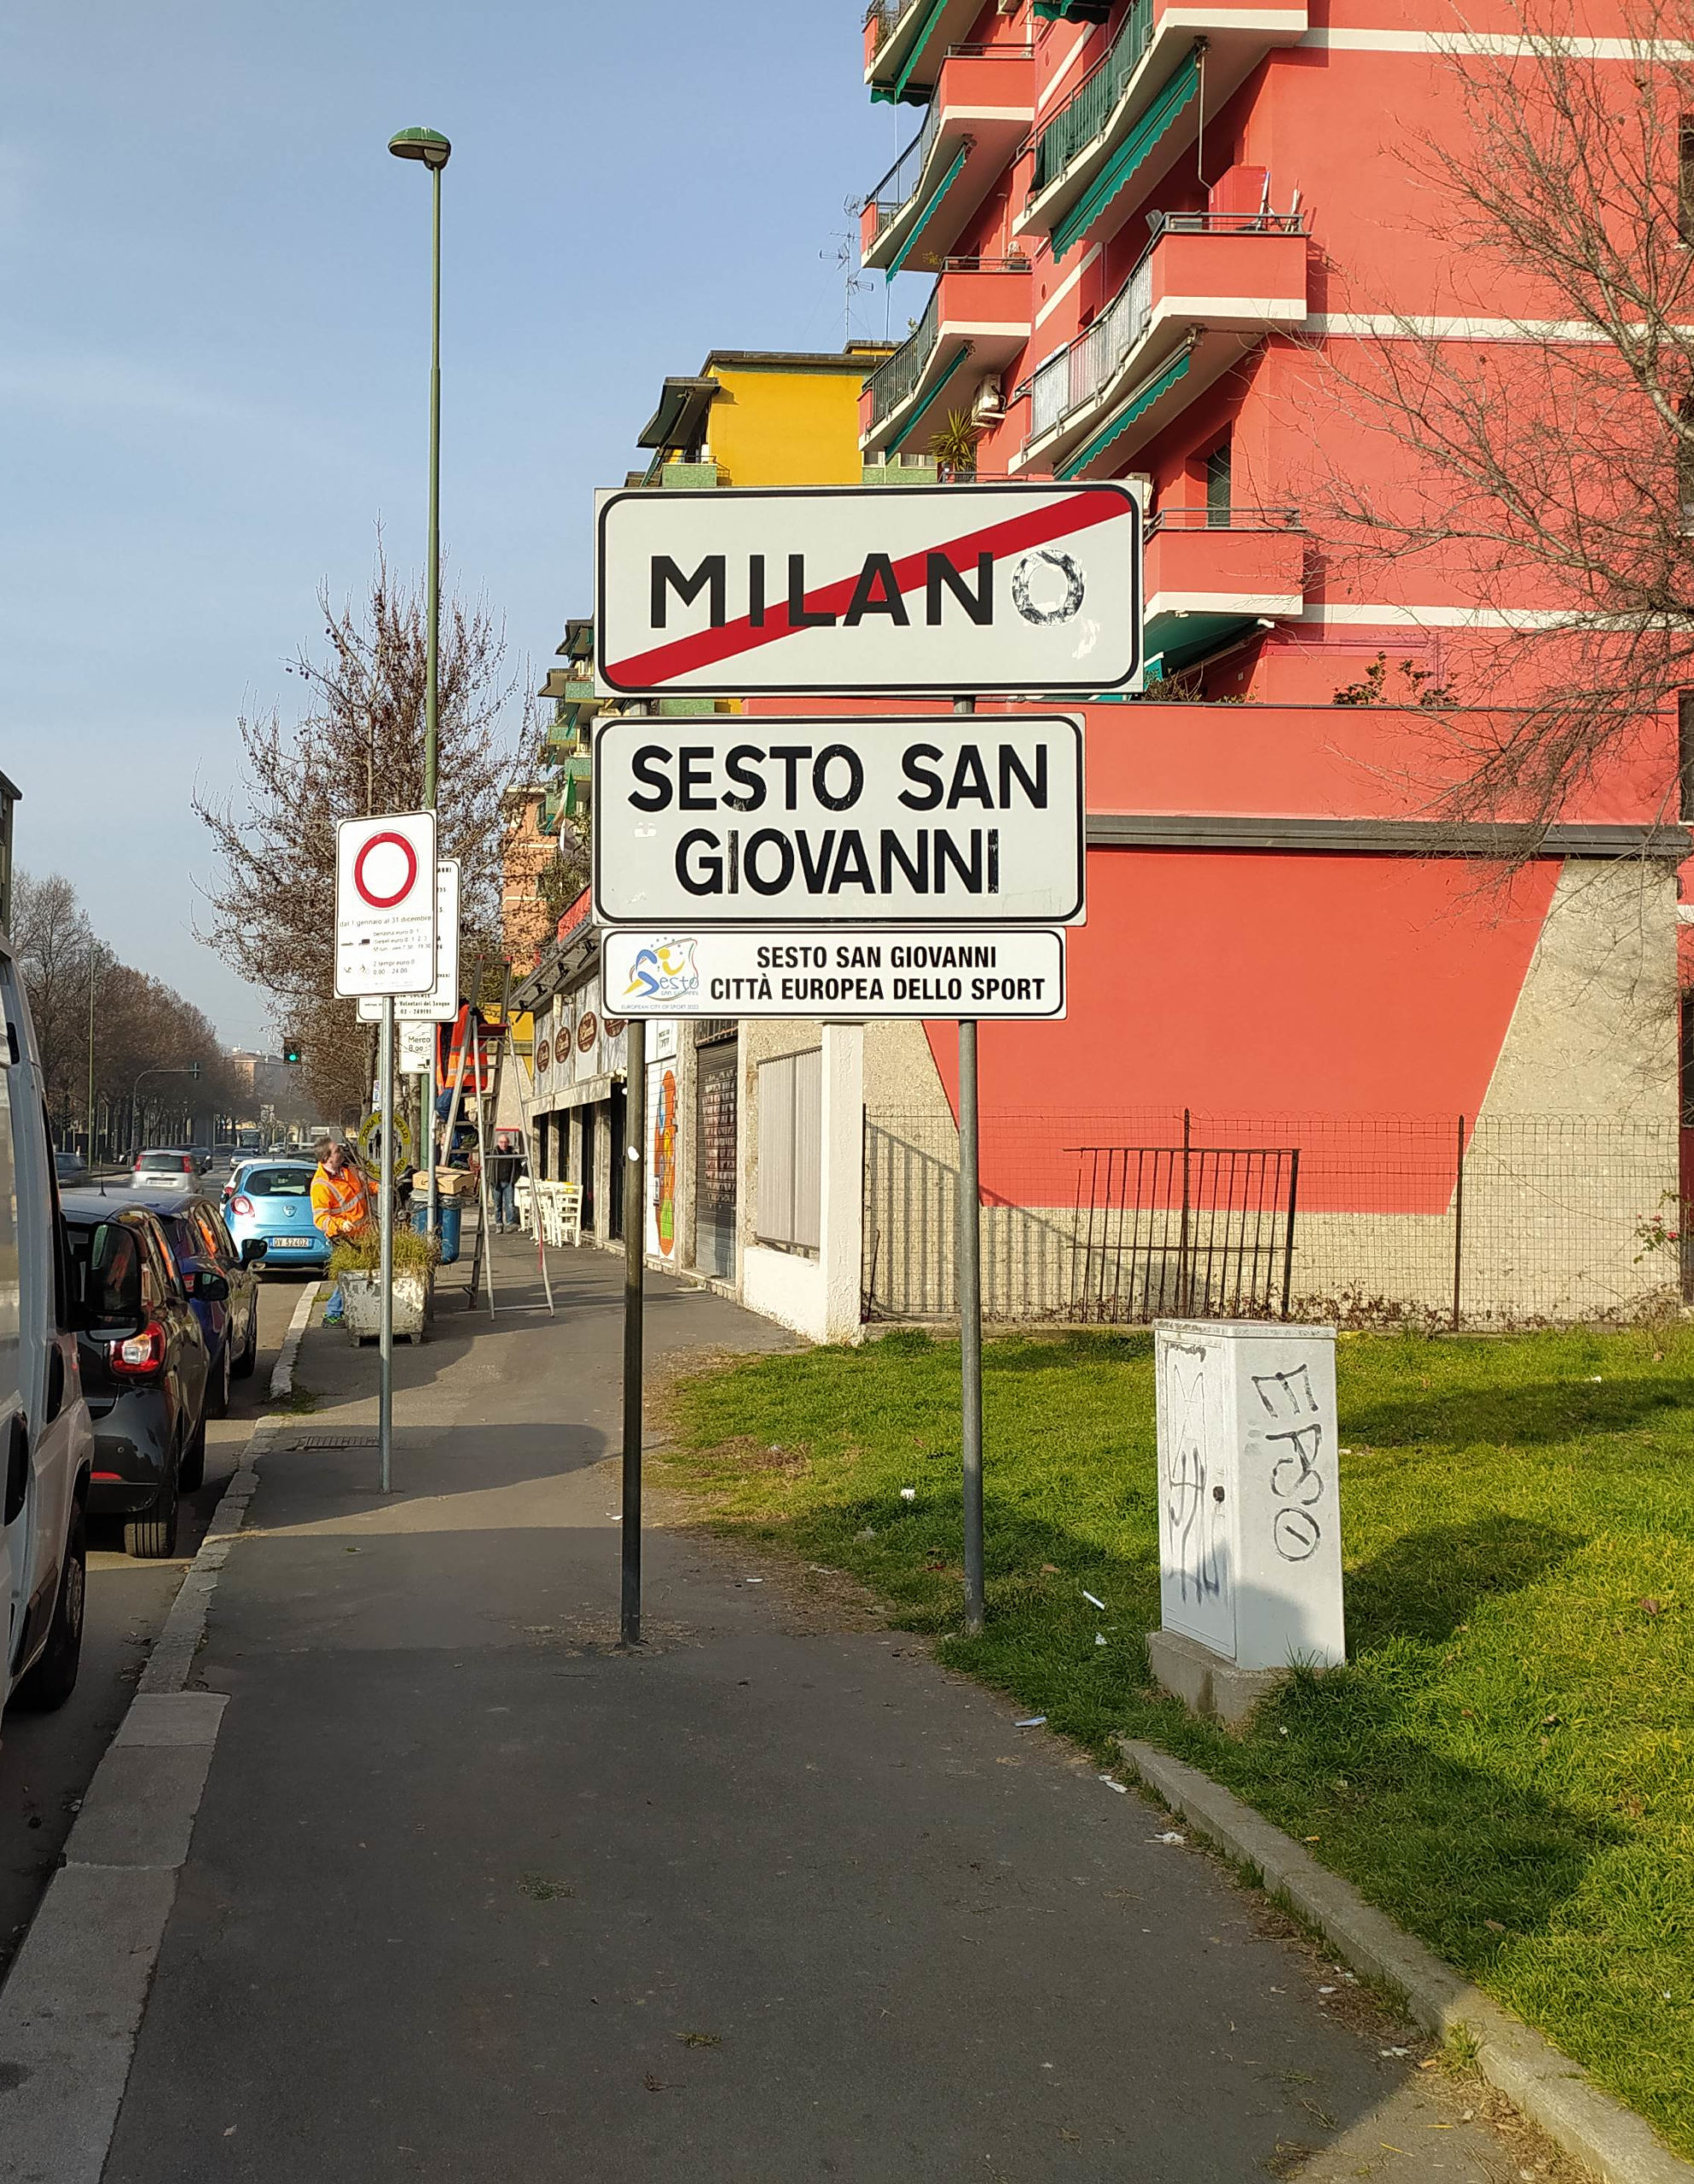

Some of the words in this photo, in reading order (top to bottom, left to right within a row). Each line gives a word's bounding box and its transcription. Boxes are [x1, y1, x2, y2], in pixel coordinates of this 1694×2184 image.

[651, 549, 1086, 629] MILANO
[628, 743, 864, 813] SESTO
[897, 743, 1048, 811] SAN
[675, 828, 1000, 897] GIOVANNI
[357, 919, 382, 927] gennaio
[757, 945, 827, 969] SESTO
[836, 945, 881, 968] SAN
[891, 944, 996, 968] GIOVANNI
[711, 973, 773, 1001] CITTÀ
[781, 979, 885, 1000] EUROPEA
[893, 978, 962, 1000] DELLO
[971, 978, 1046, 1000] SPORT
